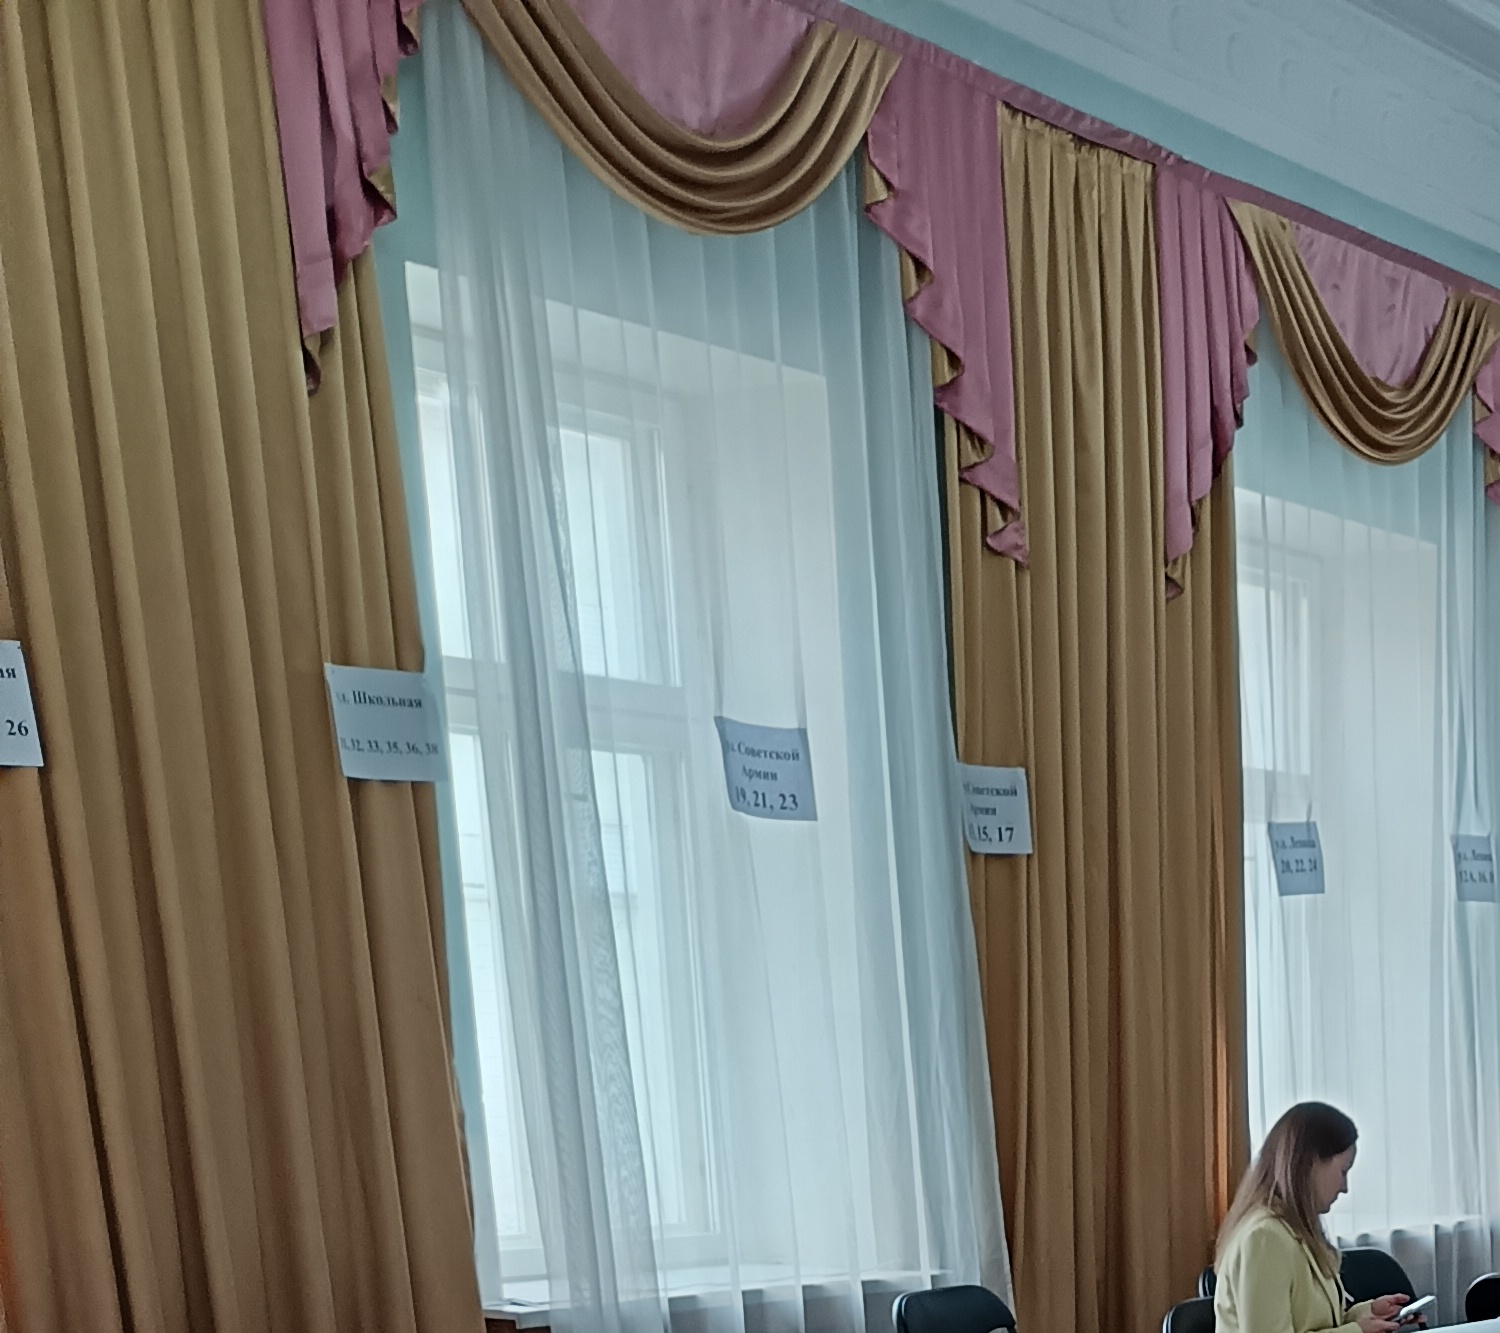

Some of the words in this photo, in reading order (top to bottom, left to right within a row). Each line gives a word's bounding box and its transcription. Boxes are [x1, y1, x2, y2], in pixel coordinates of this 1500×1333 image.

[352, 690, 422, 708] Школьная
[5, 719, 29, 736] 26
[737, 741, 800, 761] Советской
[742, 764, 778, 782] Армии
[753, 789, 774, 813] 21,
[778, 792, 798, 811] 23
[998, 826, 1014, 842] 17
